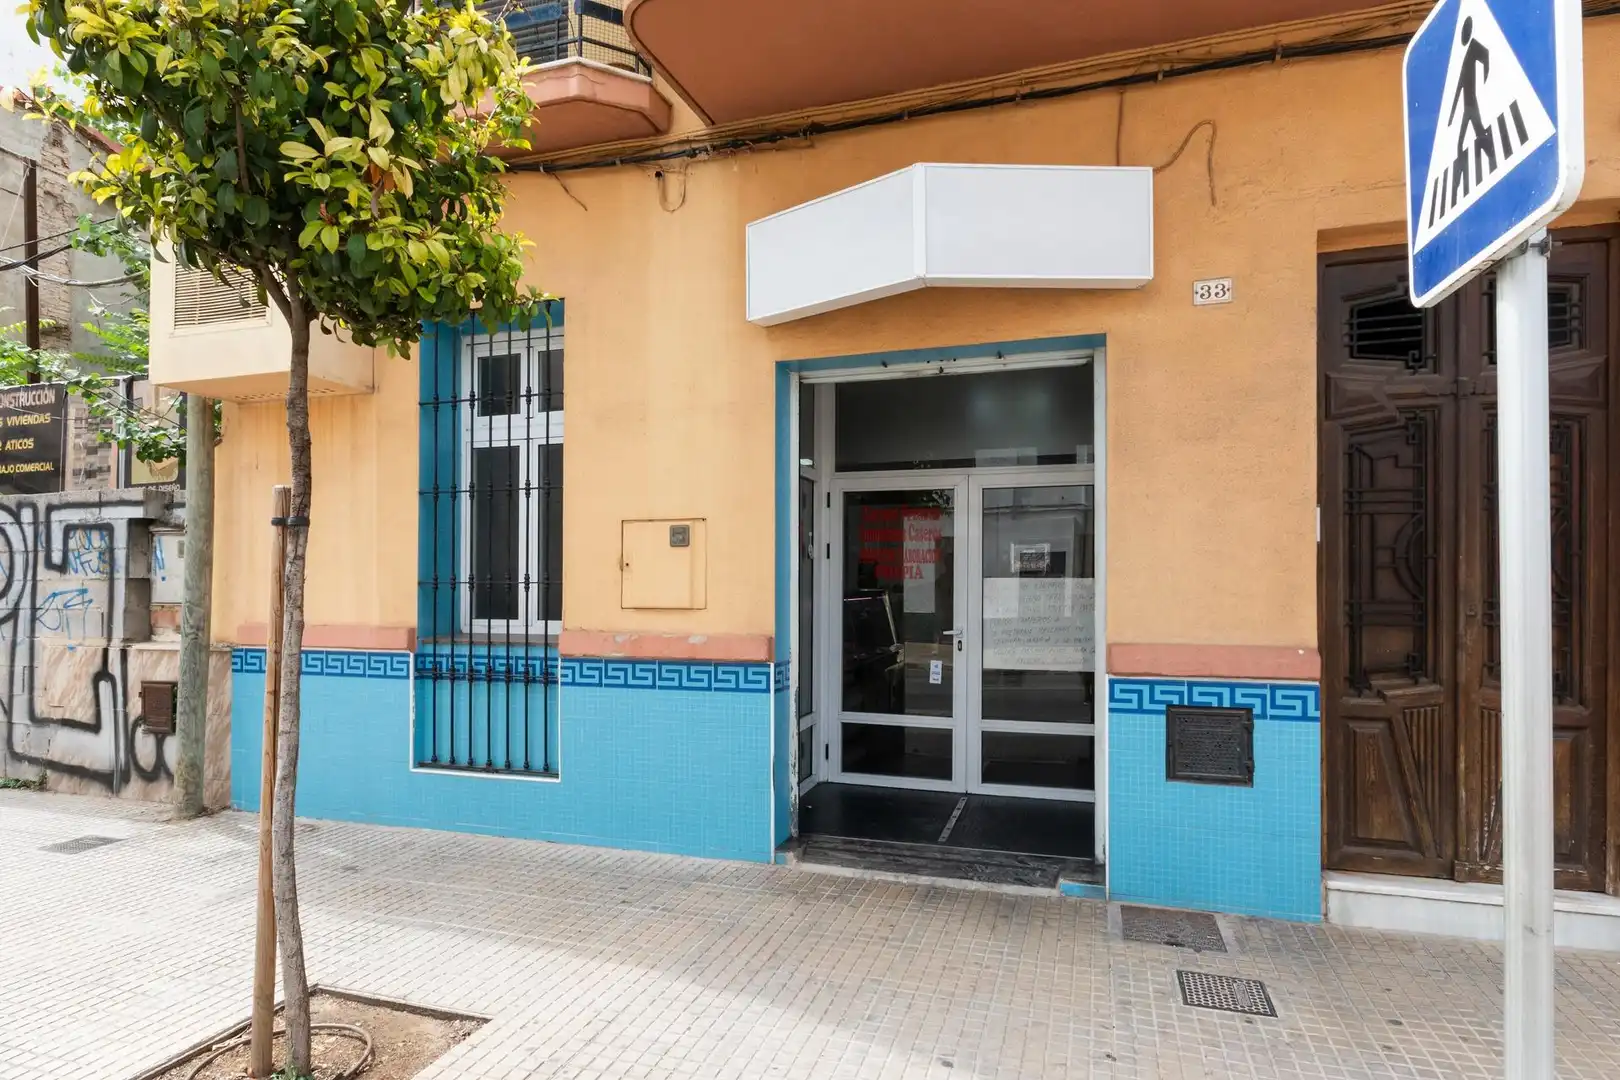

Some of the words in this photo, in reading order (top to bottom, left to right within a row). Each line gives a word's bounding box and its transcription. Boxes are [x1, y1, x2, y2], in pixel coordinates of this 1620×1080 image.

[1200, 284, 1226, 300] 33
[7, 413, 51, 426] VIVIENDAS
[5, 438, 34, 450] ATICOS
[16, 462, 54, 472] COMERCIAL
